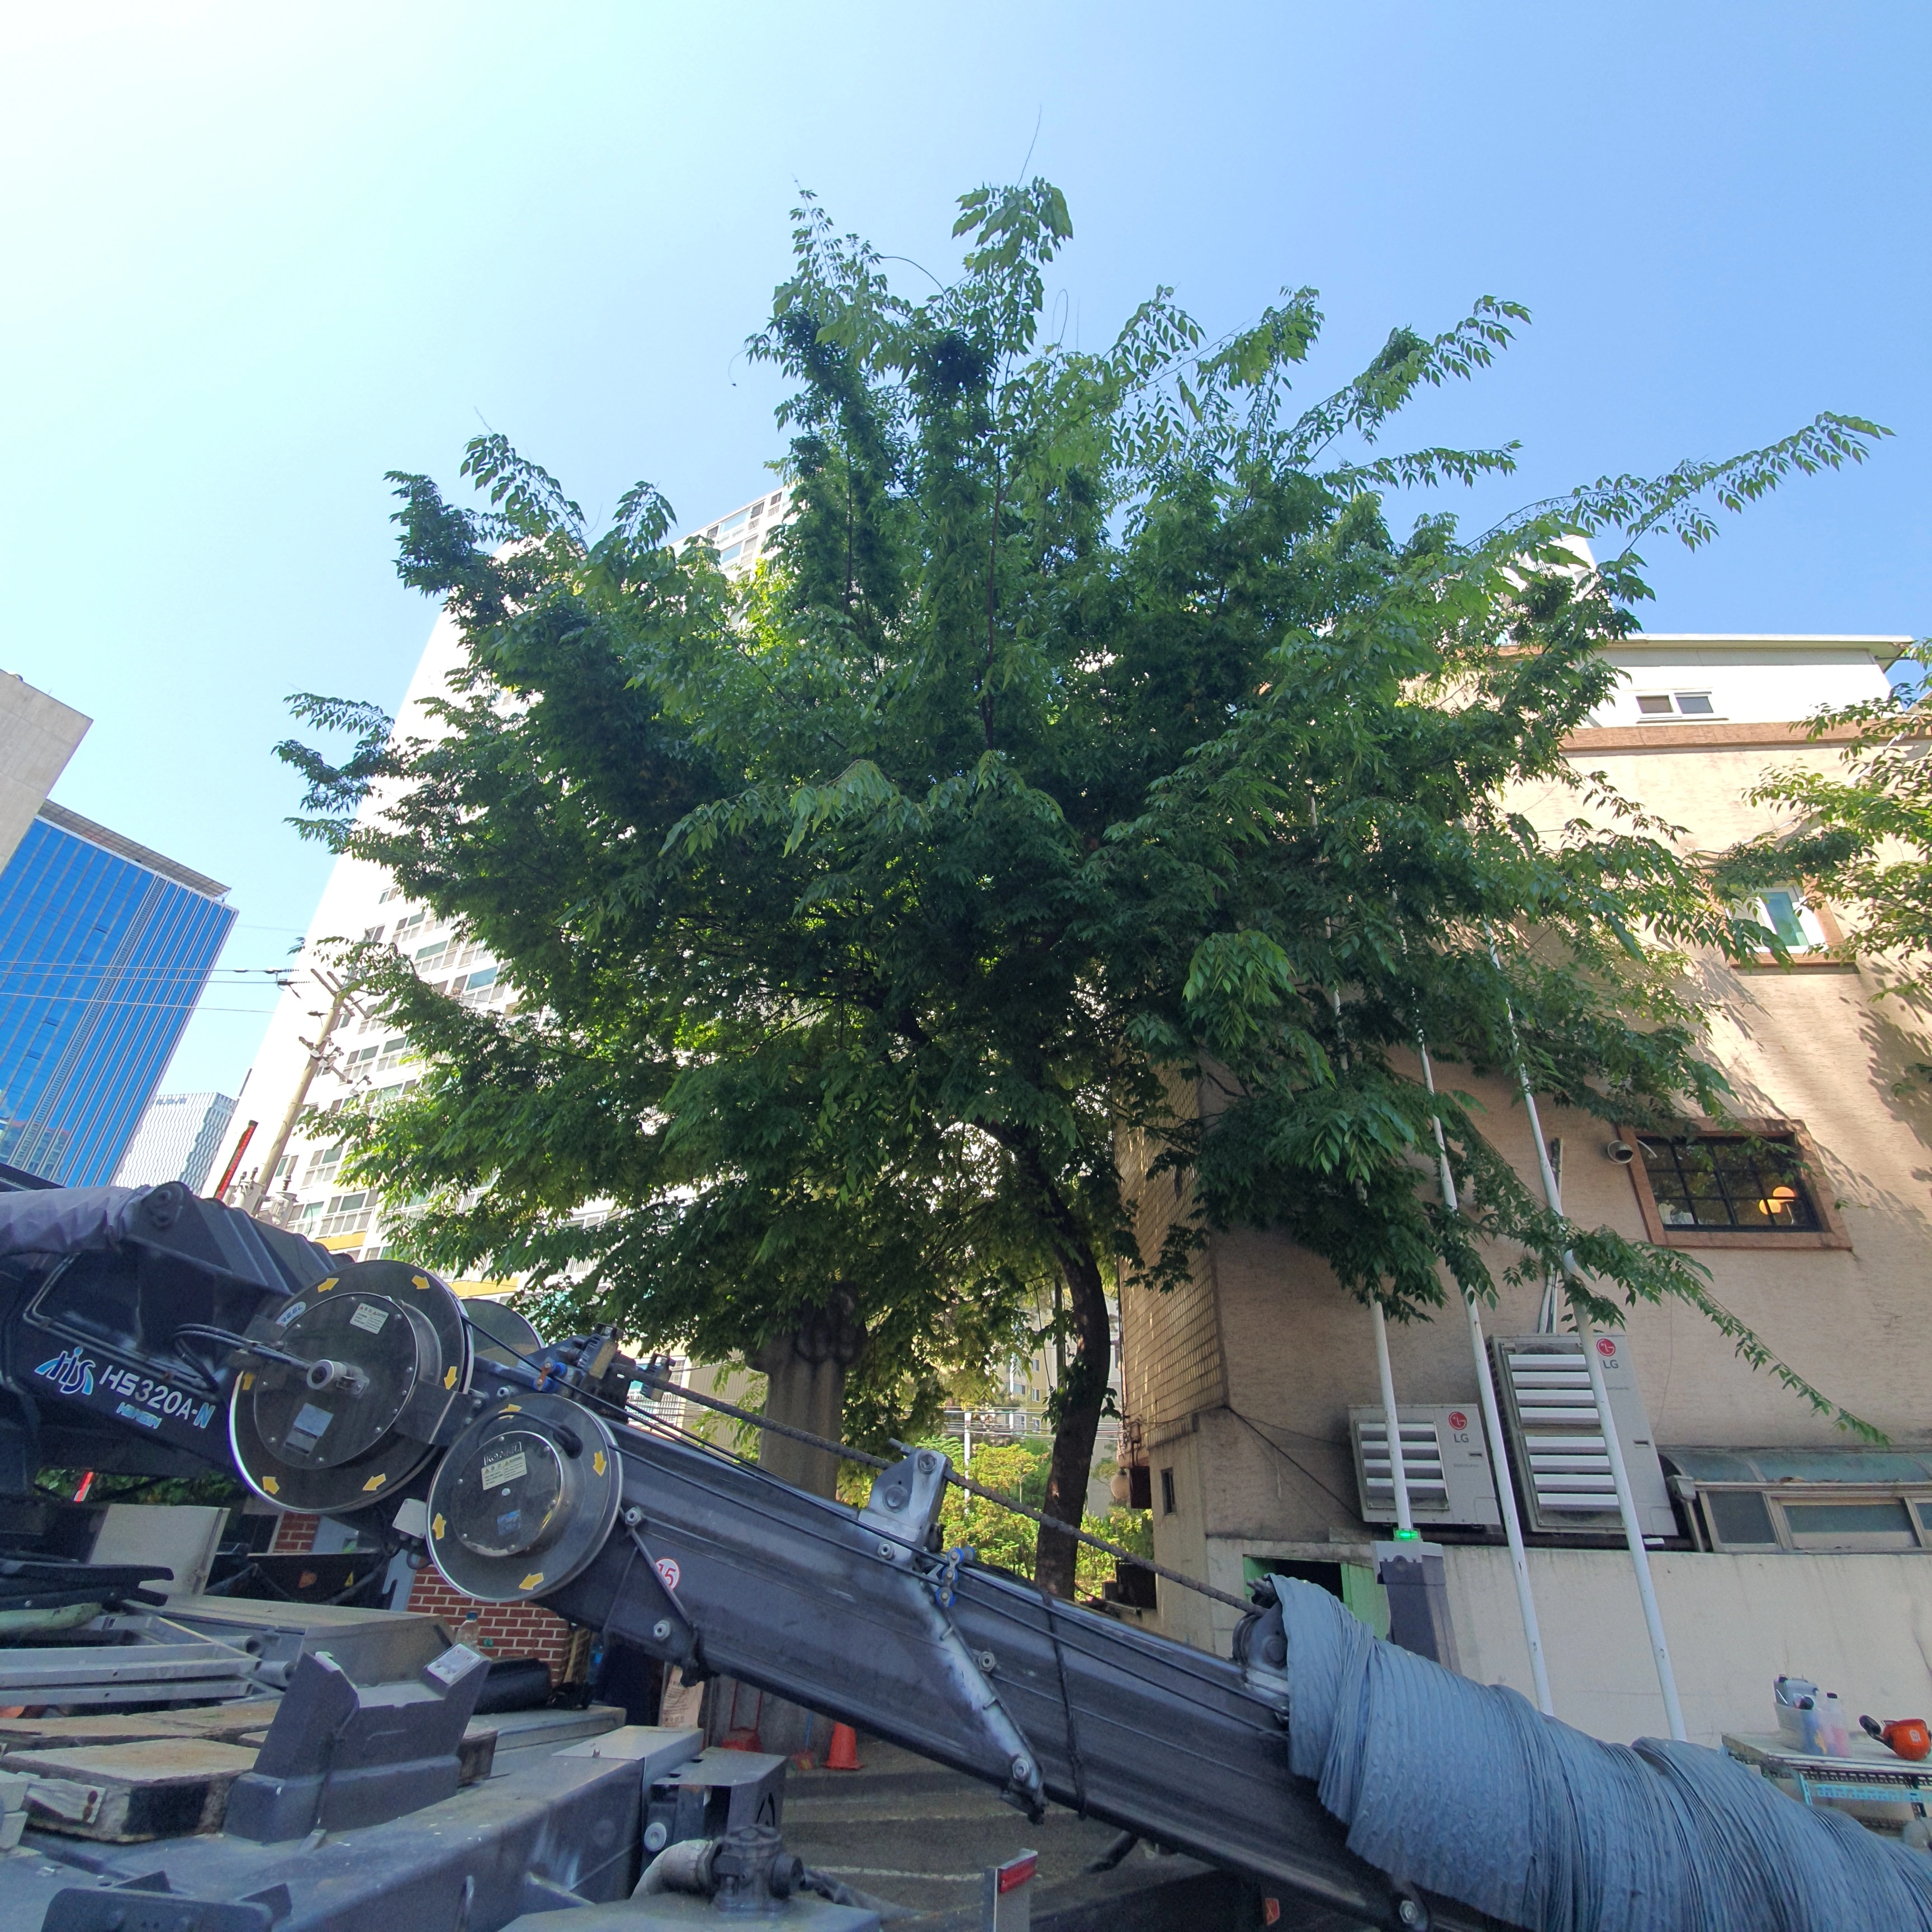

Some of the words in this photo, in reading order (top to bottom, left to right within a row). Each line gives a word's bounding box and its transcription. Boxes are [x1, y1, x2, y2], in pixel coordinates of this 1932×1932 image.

[1602, 1359, 1619, 1369] LG
[98, 1365, 216, 1428] HS320A-N
[1453, 1433, 1469, 1443] LG
